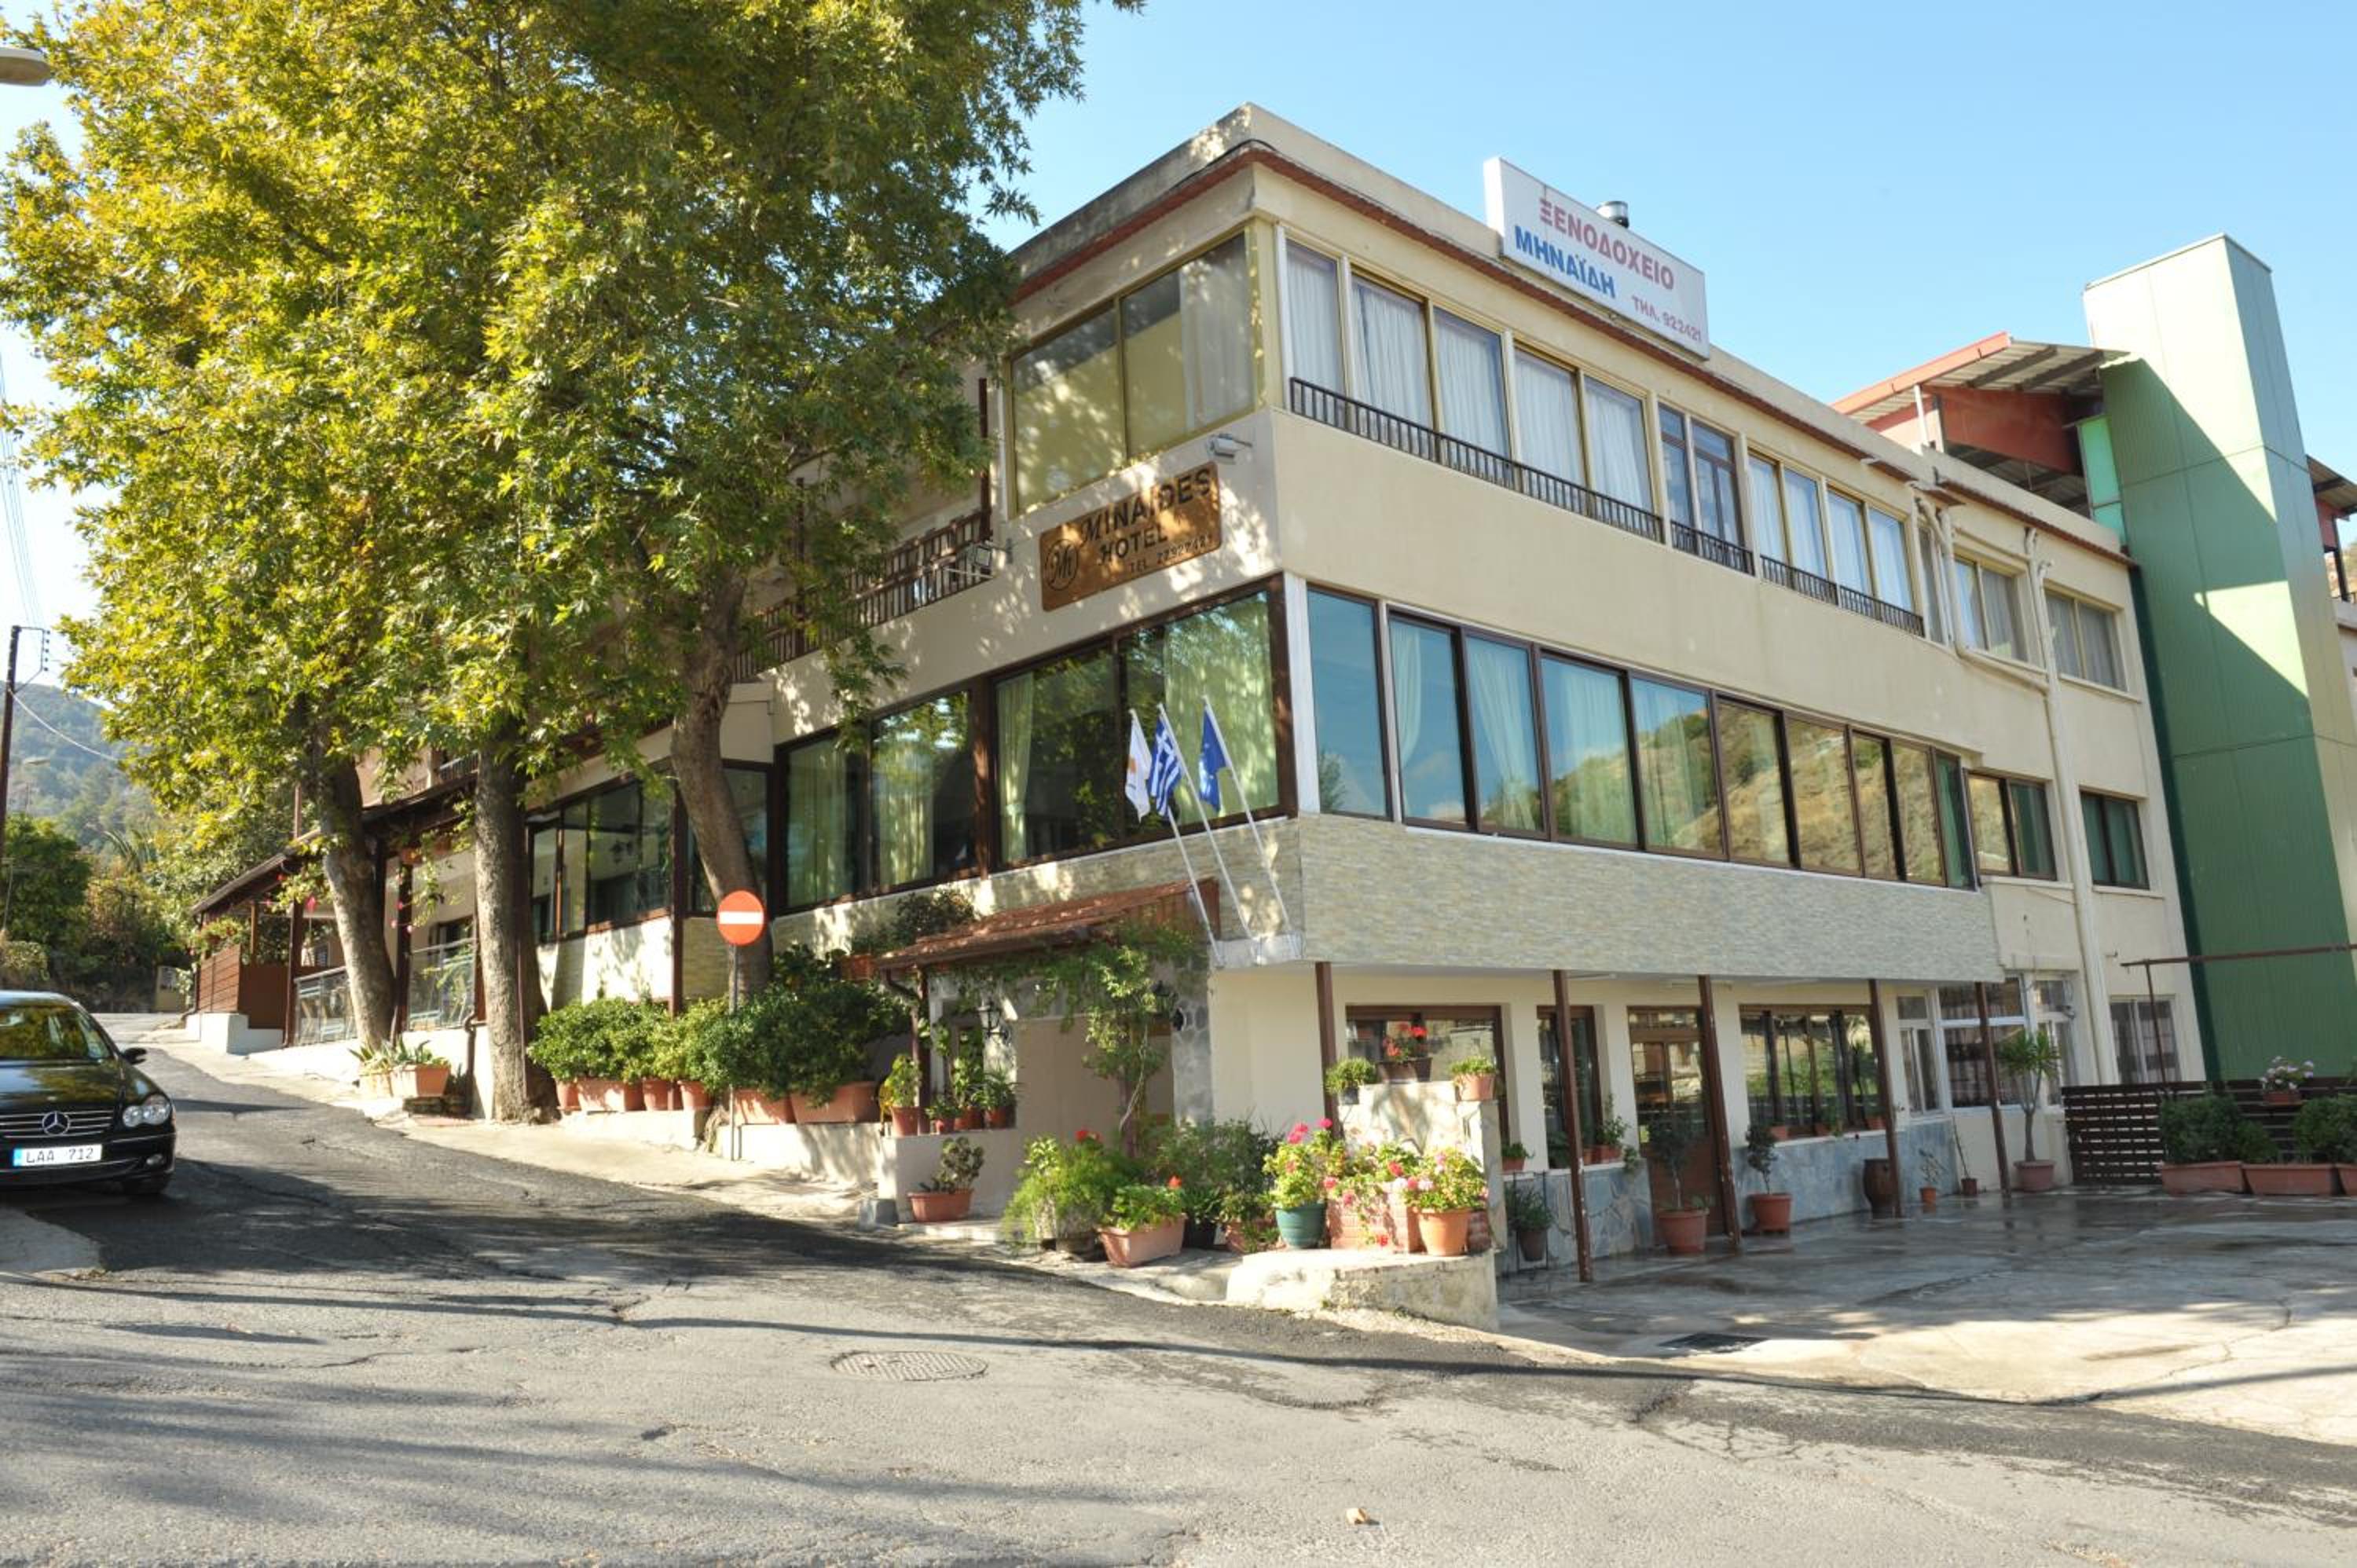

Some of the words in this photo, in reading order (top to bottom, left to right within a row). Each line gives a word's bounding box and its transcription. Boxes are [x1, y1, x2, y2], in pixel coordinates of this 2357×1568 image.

[1515, 225, 1615, 299] ΜΗΝΑΪΔΗ
[1539, 198, 1674, 290] ΞΕΝΟΔΟΧΕΙΟ
[1081, 468, 1211, 544] MINAIDES
[1098, 523, 1168, 565] HOTEL
[26, 1150, 55, 1163] LAA
[68, 1148, 93, 1160] 712
